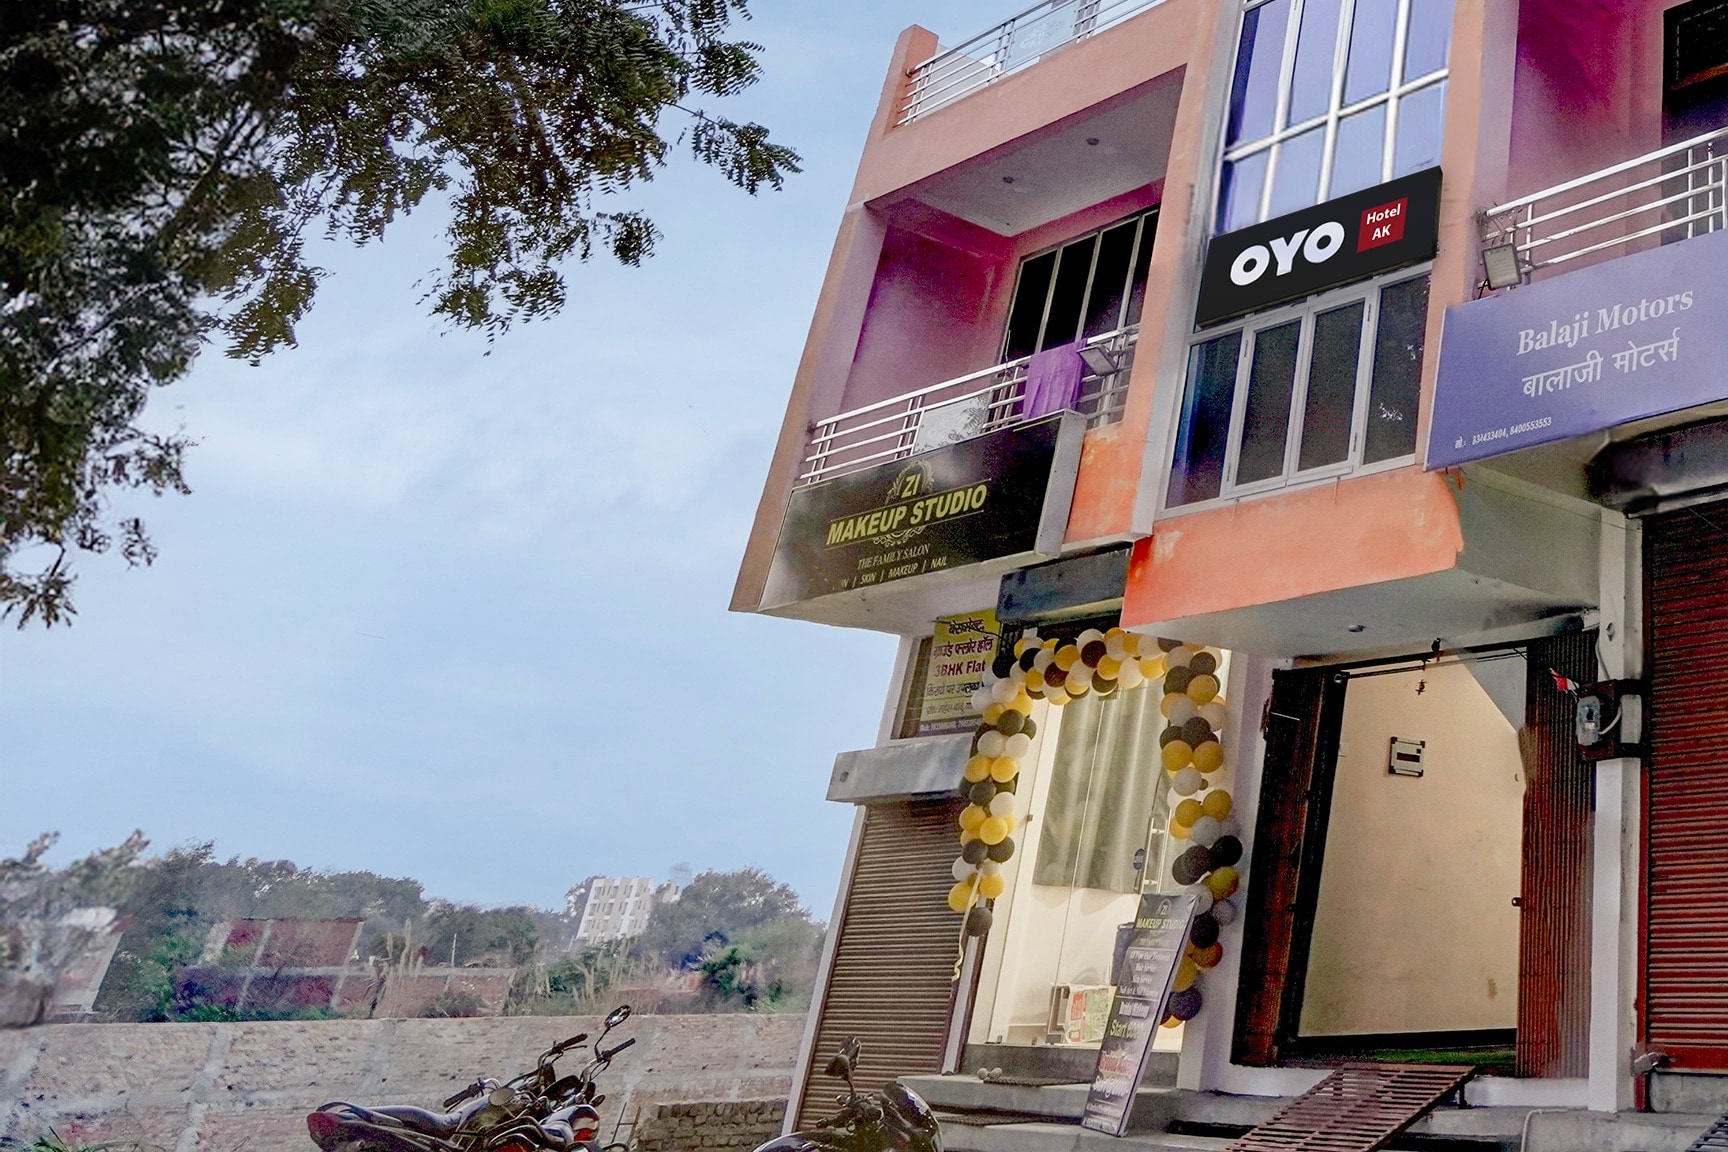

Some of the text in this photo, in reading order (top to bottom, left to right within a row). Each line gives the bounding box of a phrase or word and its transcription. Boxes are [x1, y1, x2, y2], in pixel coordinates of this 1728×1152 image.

[1366, 203, 1401, 225] Hotel
[1371, 224, 1391, 240] AK
[1230, 221, 1345, 286] OYO
[1516, 290, 1694, 356] Balaji Motors
[1522, 326, 1681, 398] बालाजी मोटर्स
[901, 474, 920, 499] ZI
[825, 484, 988, 546] MAKEUP STUDIO
[857, 543, 931, 569] THE FAMILY SALON
[860, 572, 877, 585] SKIN
[888, 562, 918, 578] MAKEUP
[931, 556, 947, 569] NAIL
[934, 659, 986, 677] 3BHK Flat
[1135, 917, 1162, 929] MAKEUP
